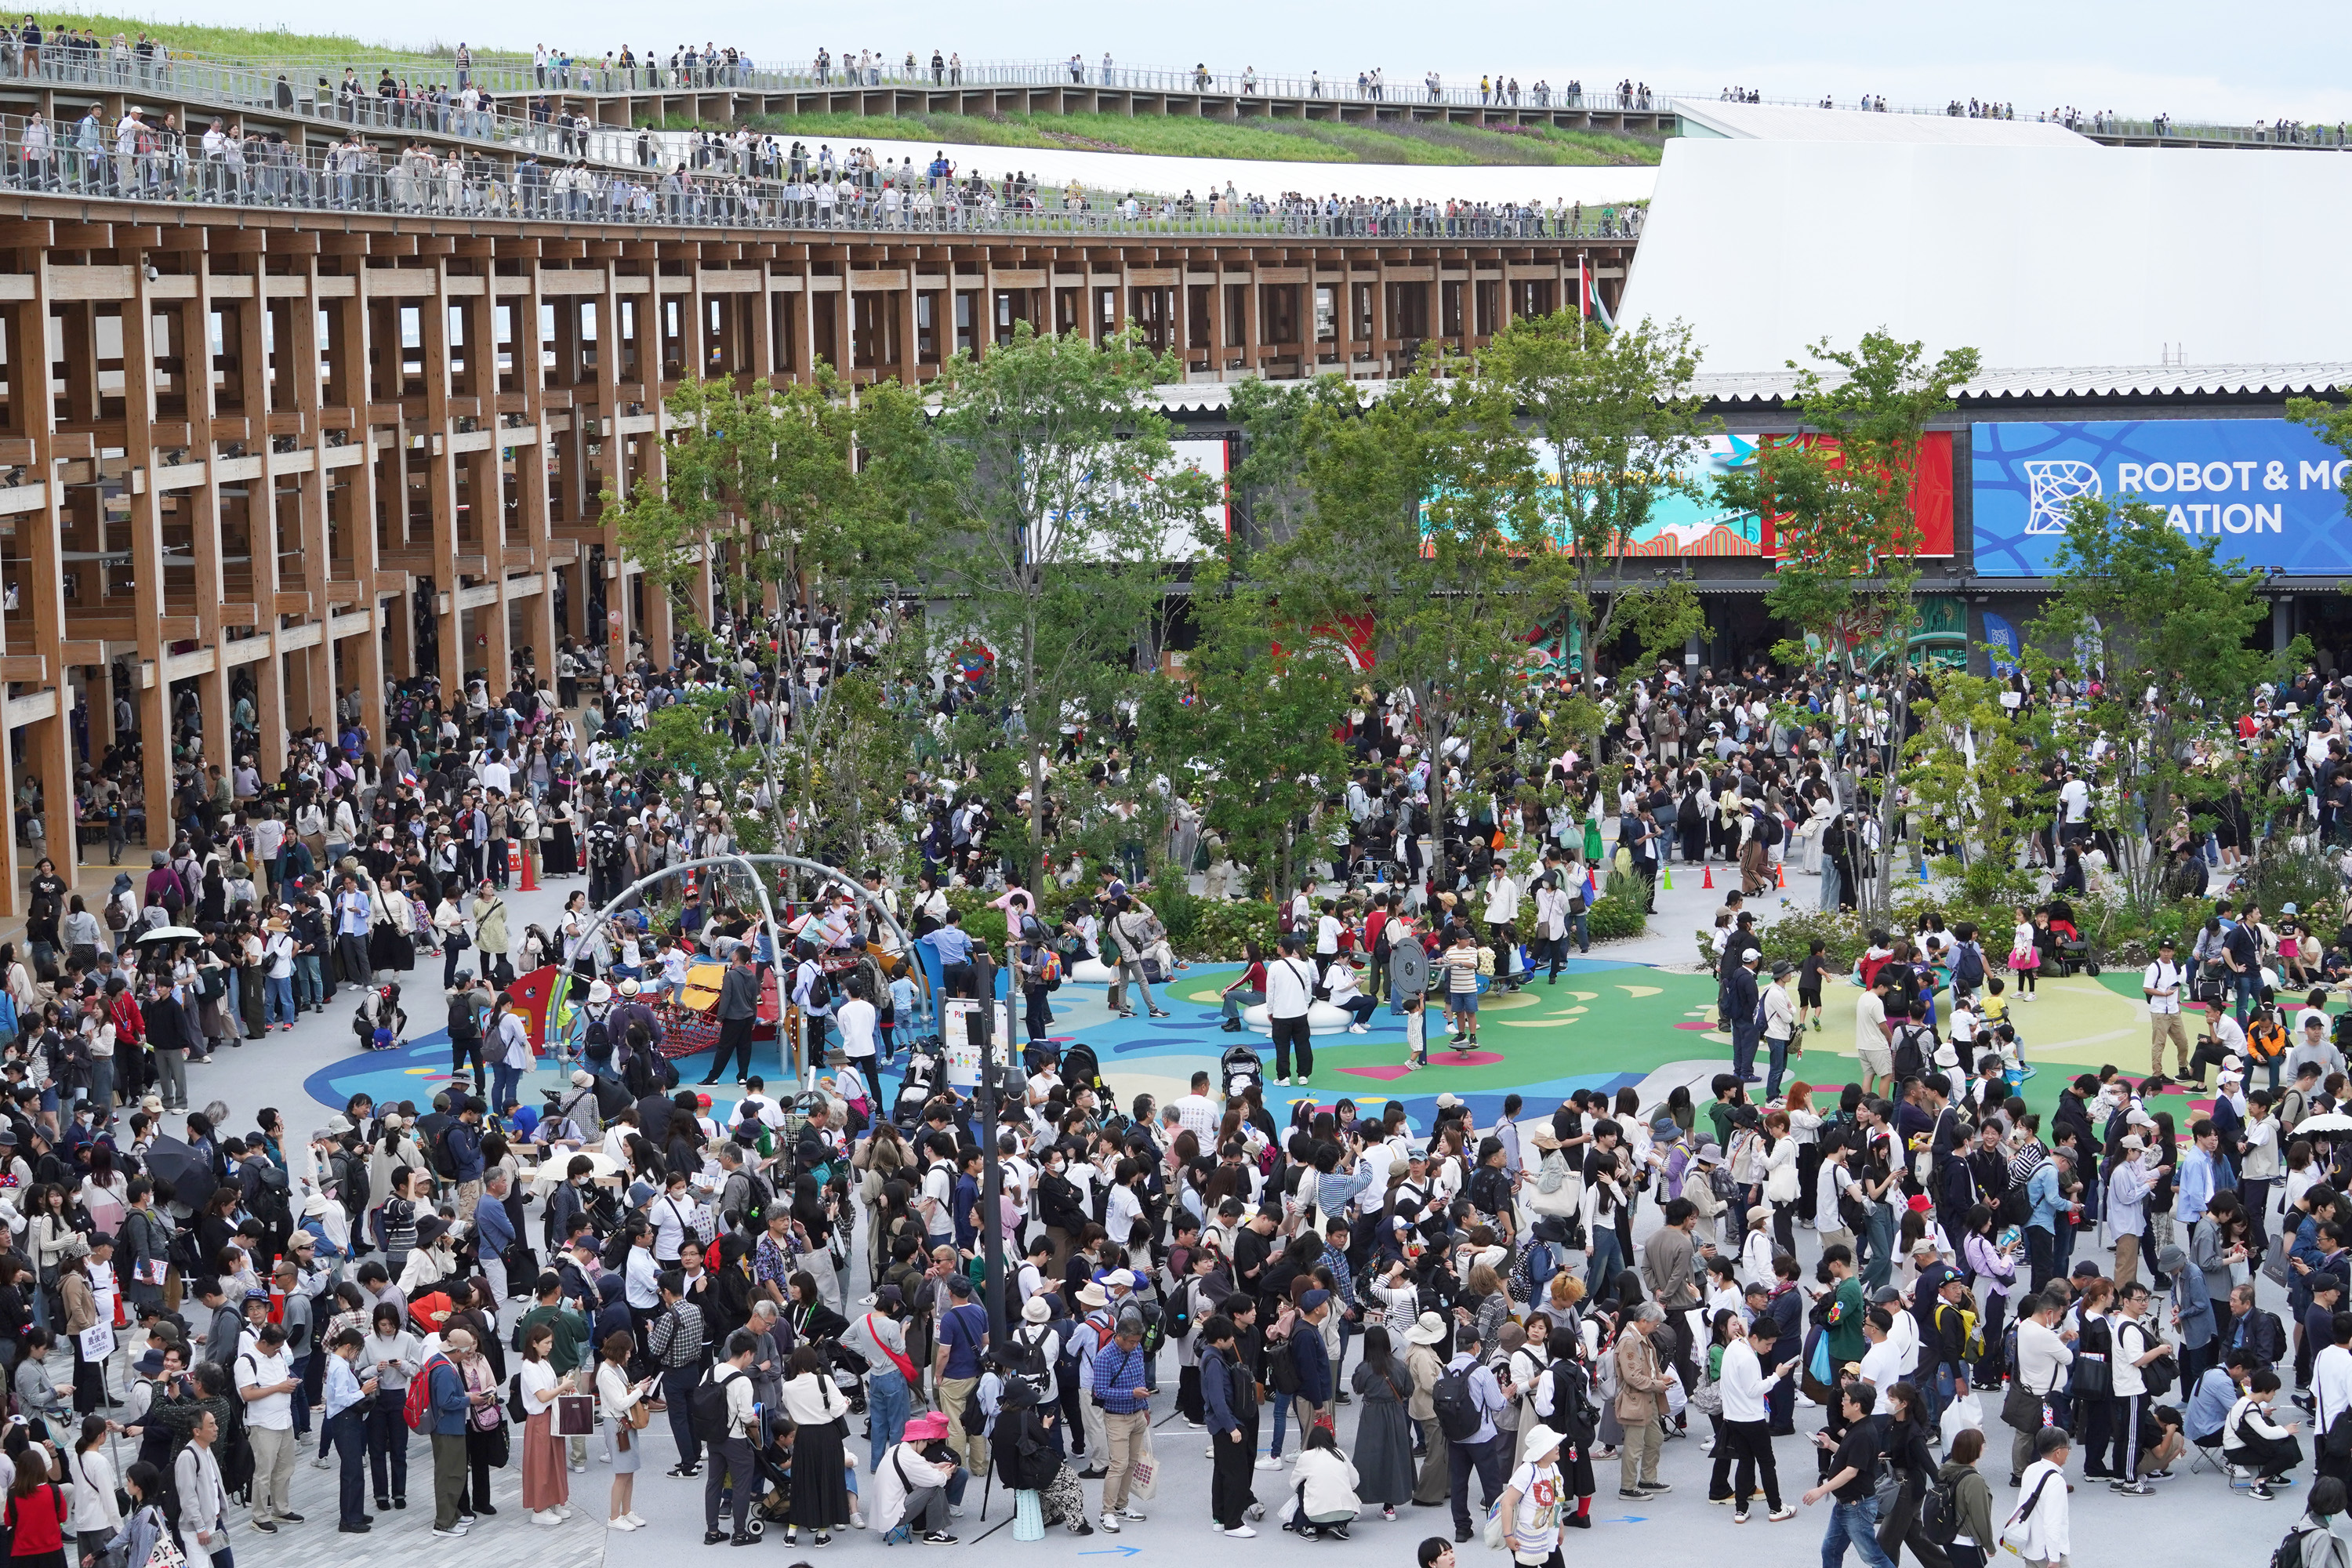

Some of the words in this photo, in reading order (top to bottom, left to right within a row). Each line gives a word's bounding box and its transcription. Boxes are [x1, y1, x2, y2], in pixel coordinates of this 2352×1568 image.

[2118, 461, 2257, 492] ROBOT
[2263, 460, 2289, 491] &
[2118, 503, 2281, 533] SATION
[88, 1331, 107, 1345] 最後尾
